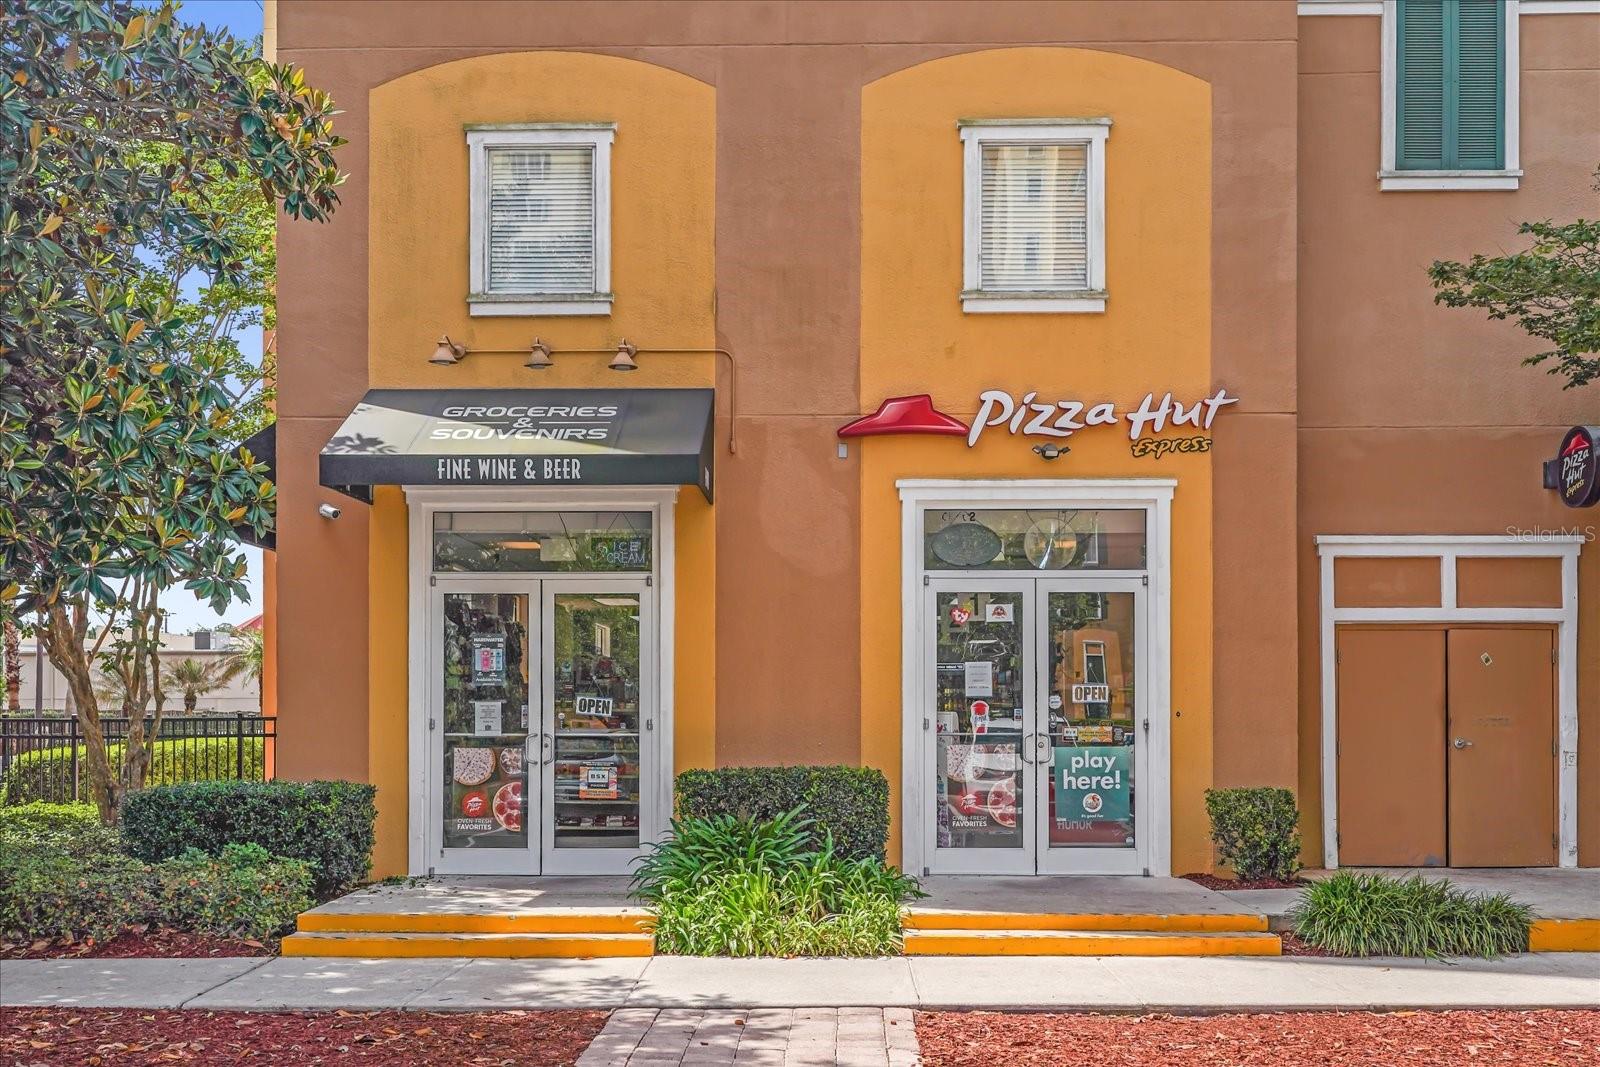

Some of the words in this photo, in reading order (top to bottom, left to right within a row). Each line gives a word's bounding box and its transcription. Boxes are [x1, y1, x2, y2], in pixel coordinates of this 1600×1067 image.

[442, 406, 618, 417] GROCERIES
[967, 390, 1119, 447] Pizza
[1127, 389, 1240, 439] Hut
[512, 417, 534, 428] &
[429, 428, 608, 440] SOUVENIRS
[1131, 437, 1211, 459] Express
[437, 458, 471, 480] FINE
[477, 458, 517, 480] WINE
[523, 458, 536, 480] &
[543, 458, 582, 480] BEER
[1562, 449, 1589, 480] Pizza
[1566, 463, 1587, 488] Hut
[613, 541, 639, 552] ICE
[606, 552, 645, 563] CREAM
[1074, 686, 1107, 701] OPEN
[579, 698, 611, 714] OPEN
[1071, 750, 1116, 773] play
[1063, 769, 1121, 790] here!
